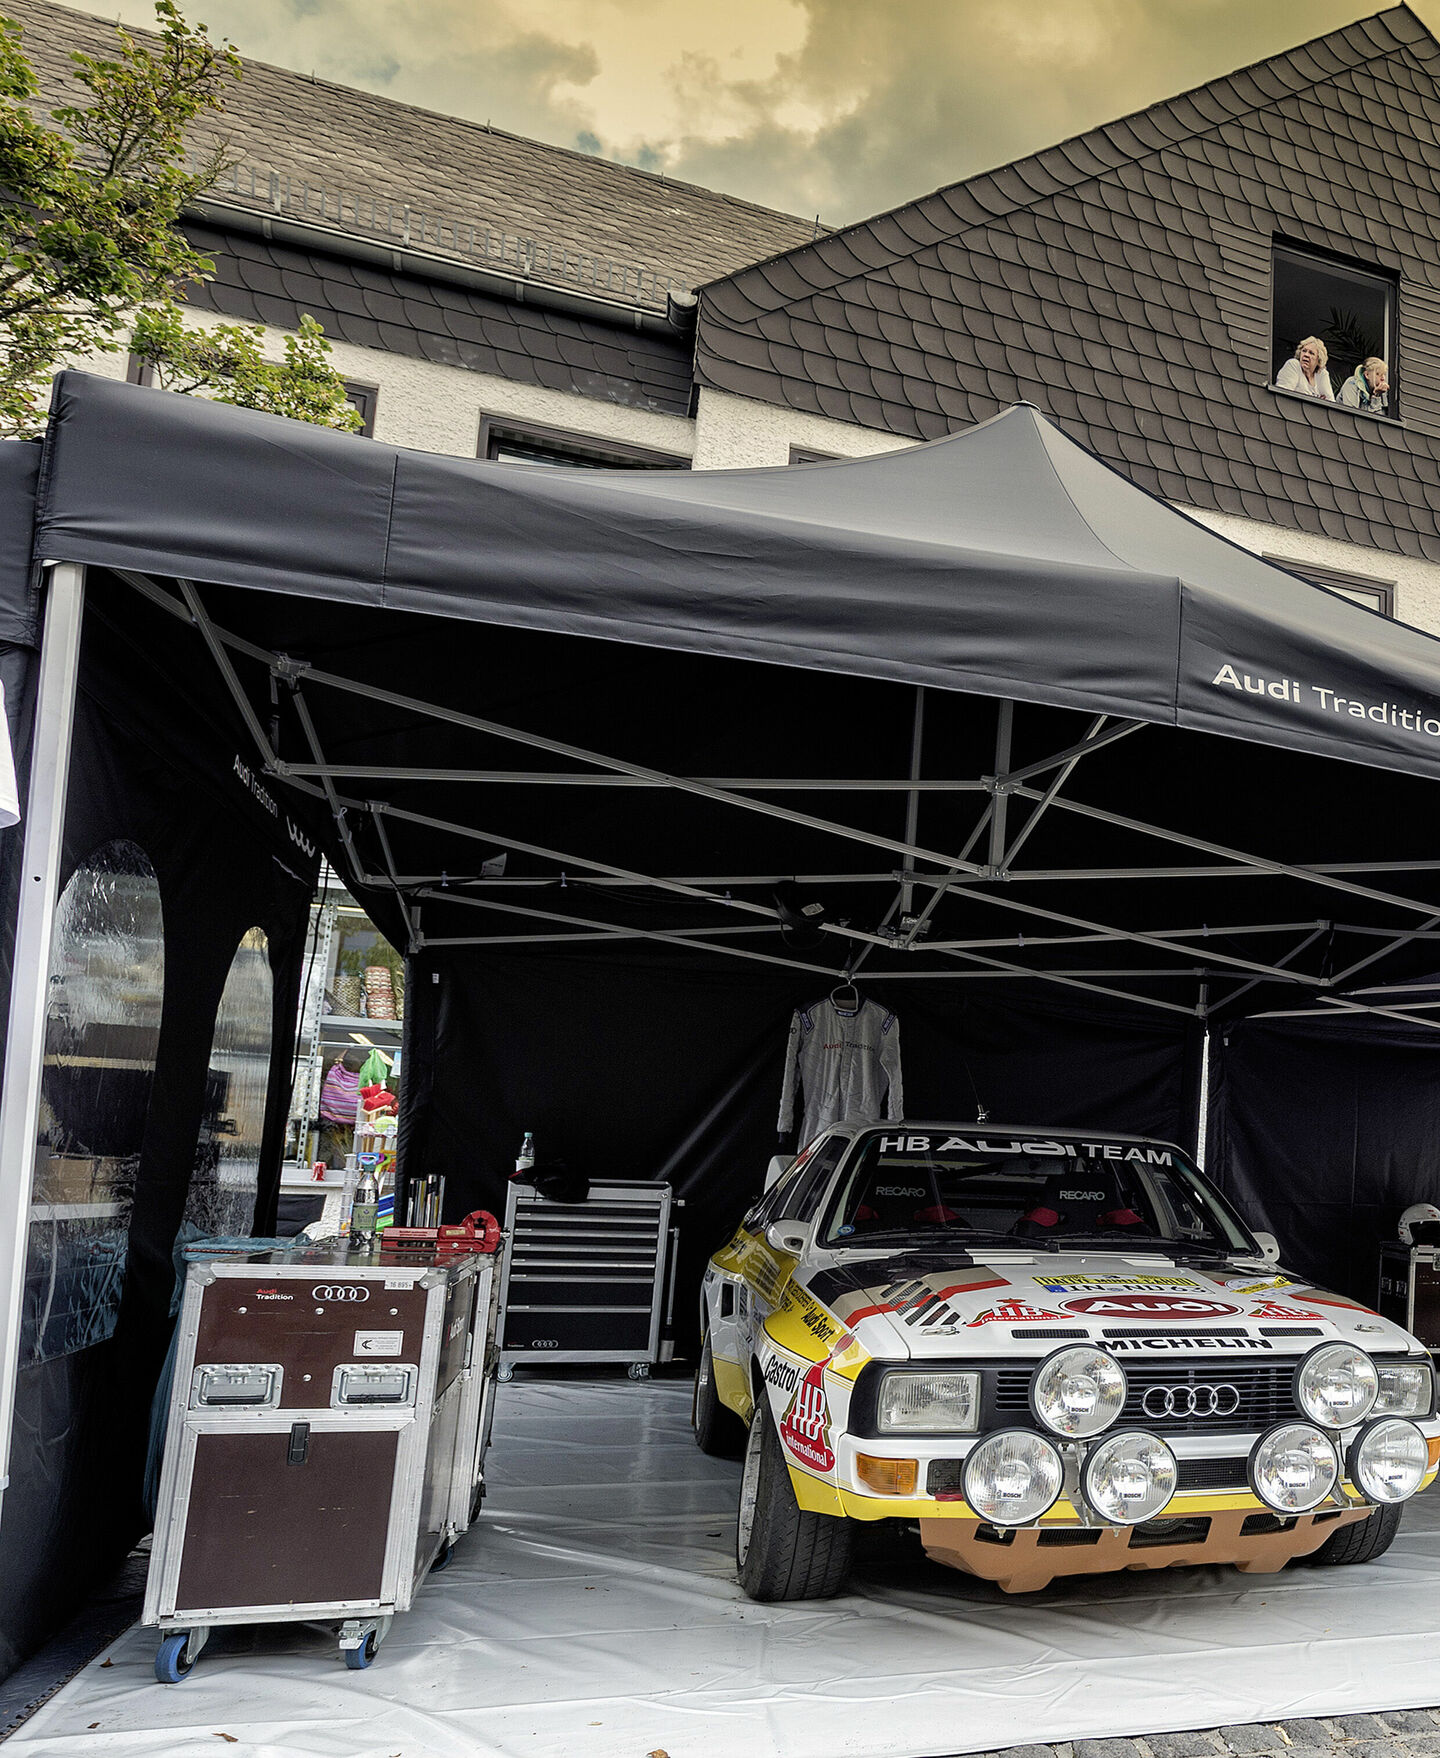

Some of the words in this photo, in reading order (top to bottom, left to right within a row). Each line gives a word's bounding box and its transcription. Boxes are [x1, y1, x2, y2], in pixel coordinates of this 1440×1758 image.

[1212, 663, 1300, 705] Audi
[879, 1136, 931, 1153] HB
[1081, 1143, 1173, 1167] TEAM
[875, 1186, 926, 1198] RECARO
[1059, 1190, 1105, 1201] RECARO
[801, 1307, 824, 1328] Audi
[992, 1307, 1044, 1317] HB
[810, 1316, 835, 1343] Sport
[1095, 1338, 1273, 1351] MICHELIN
[765, 1355, 801, 1393] Castrol
[793, 1378, 827, 1441] HB
[785, 1430, 828, 1467] international
